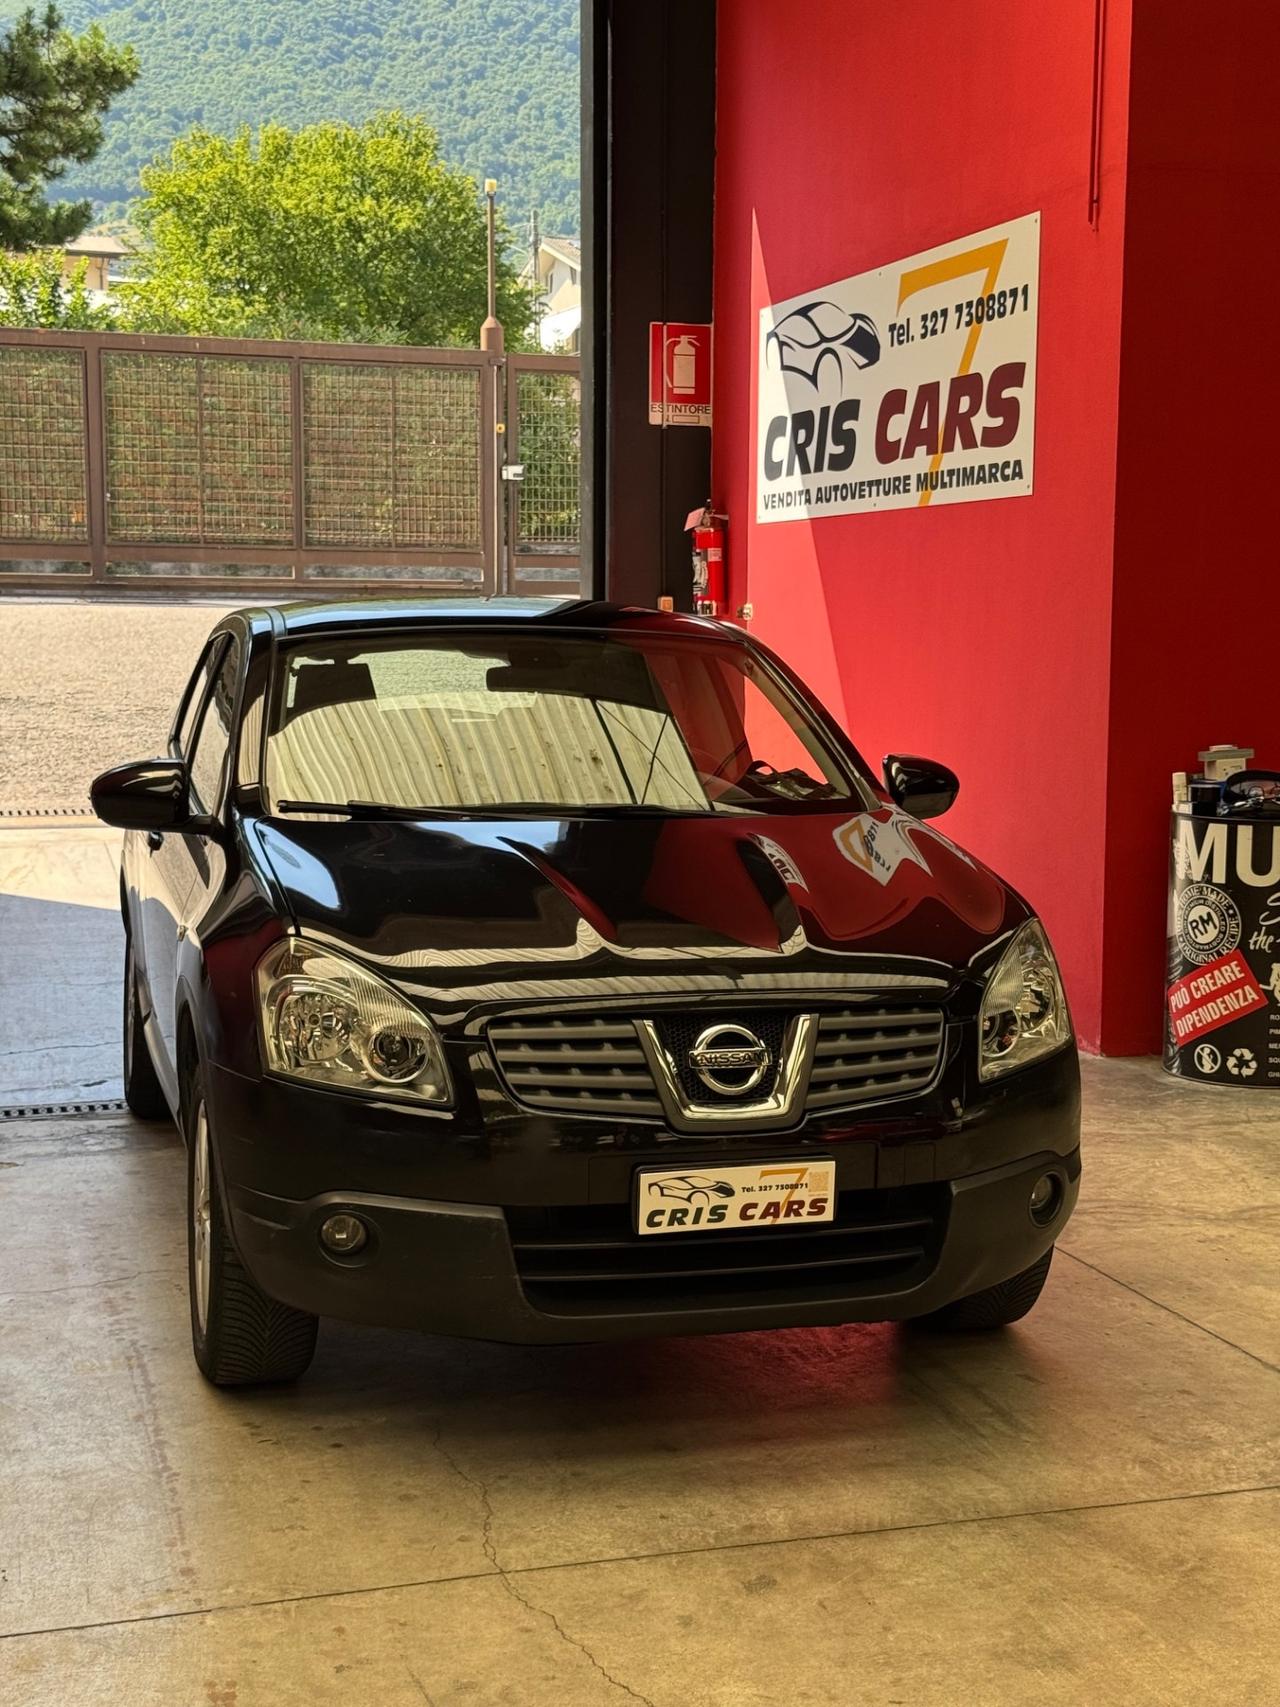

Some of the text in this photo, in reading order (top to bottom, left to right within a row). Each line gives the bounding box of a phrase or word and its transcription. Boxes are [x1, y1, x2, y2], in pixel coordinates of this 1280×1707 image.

[888, 284, 1029, 347] Tel. 327 7308871
[651, 404, 711, 414] ESTINTORE
[764, 362, 1026, 481] CRIS CARS
[763, 459, 1024, 510] VENDITA AUTOVETTURE MULTIMARCA
[1189, 911, 1217, 939] RM
[1170, 984, 1190, 1013] PUÒ
[1190, 961, 1245, 999] CREARE
[1176, 985, 1259, 1037] DIPENDENZA
[700, 1052, 762, 1065] NISSAN
[646, 1198, 828, 1228] CRIS CARS
